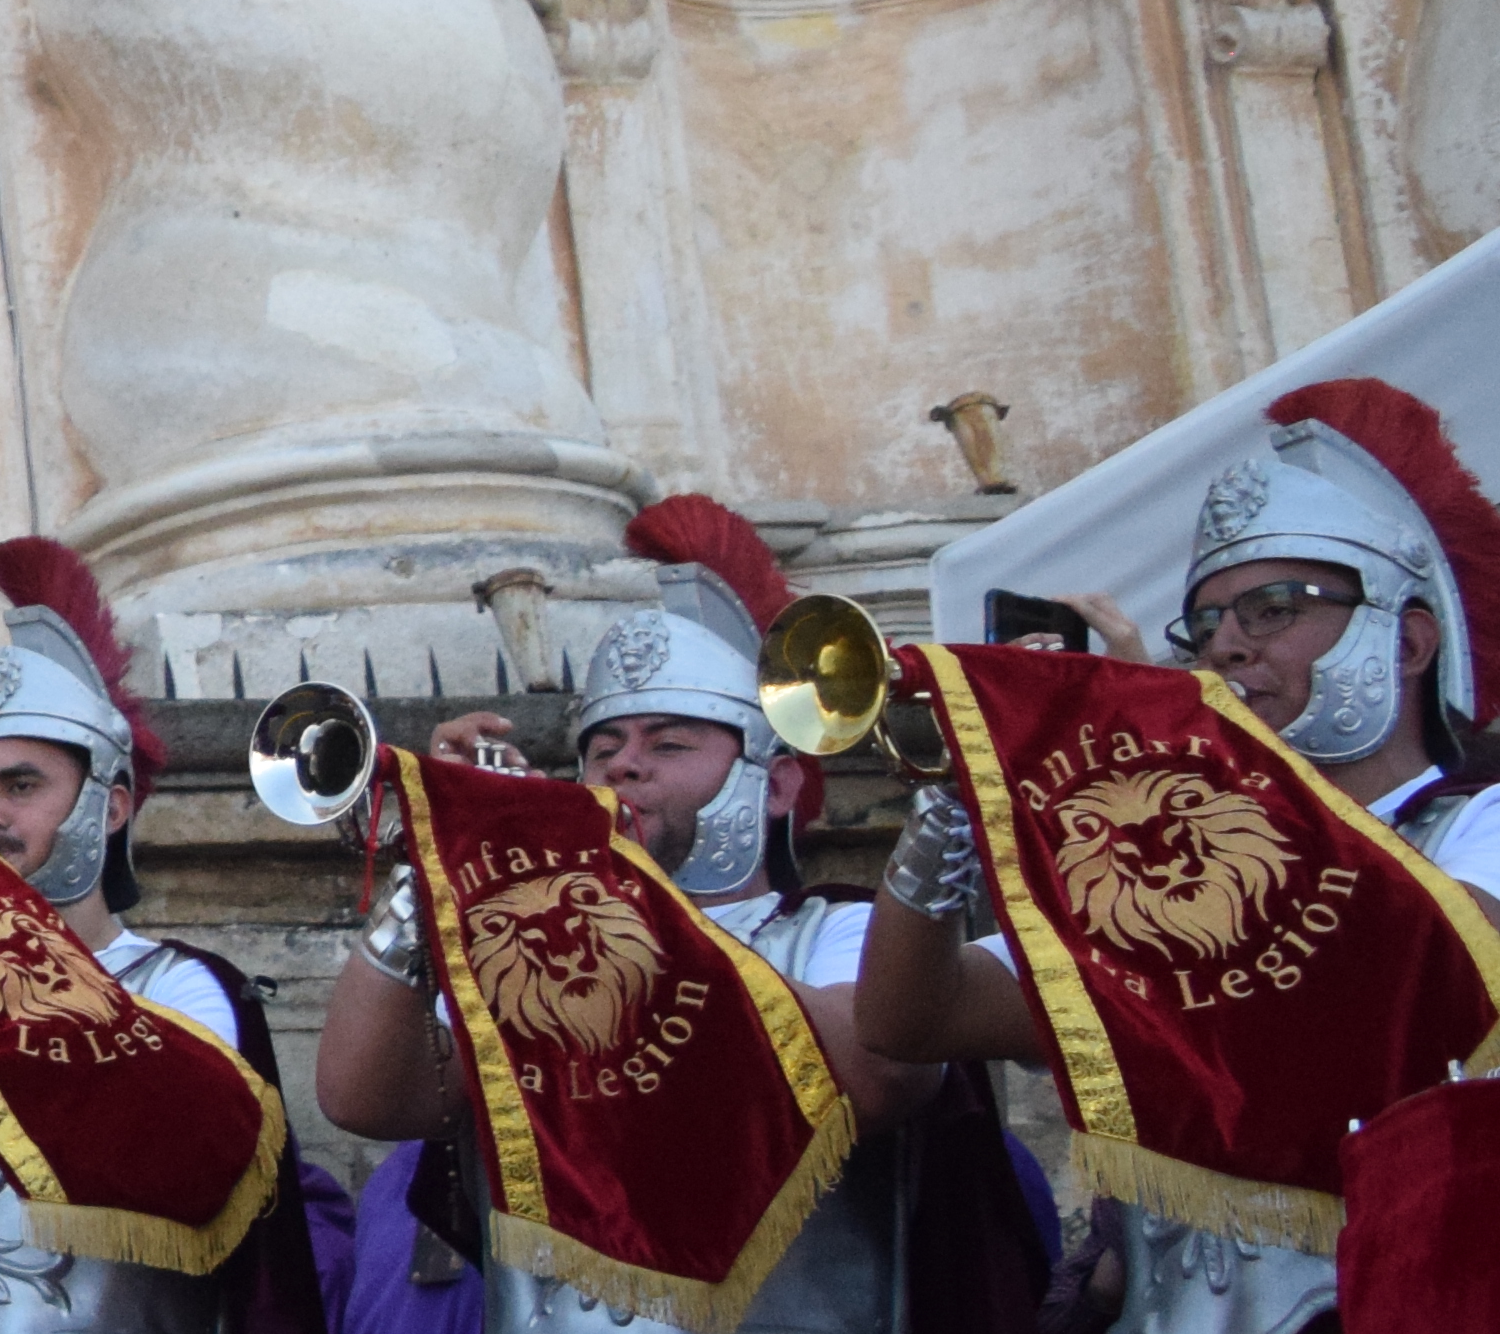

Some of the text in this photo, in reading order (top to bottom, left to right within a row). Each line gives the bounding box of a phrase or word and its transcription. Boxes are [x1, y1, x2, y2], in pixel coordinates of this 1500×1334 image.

[1172, 864, 1359, 1011] Legión
[15, 1023, 72, 1064] La
[569, 979, 711, 1100] Legión
